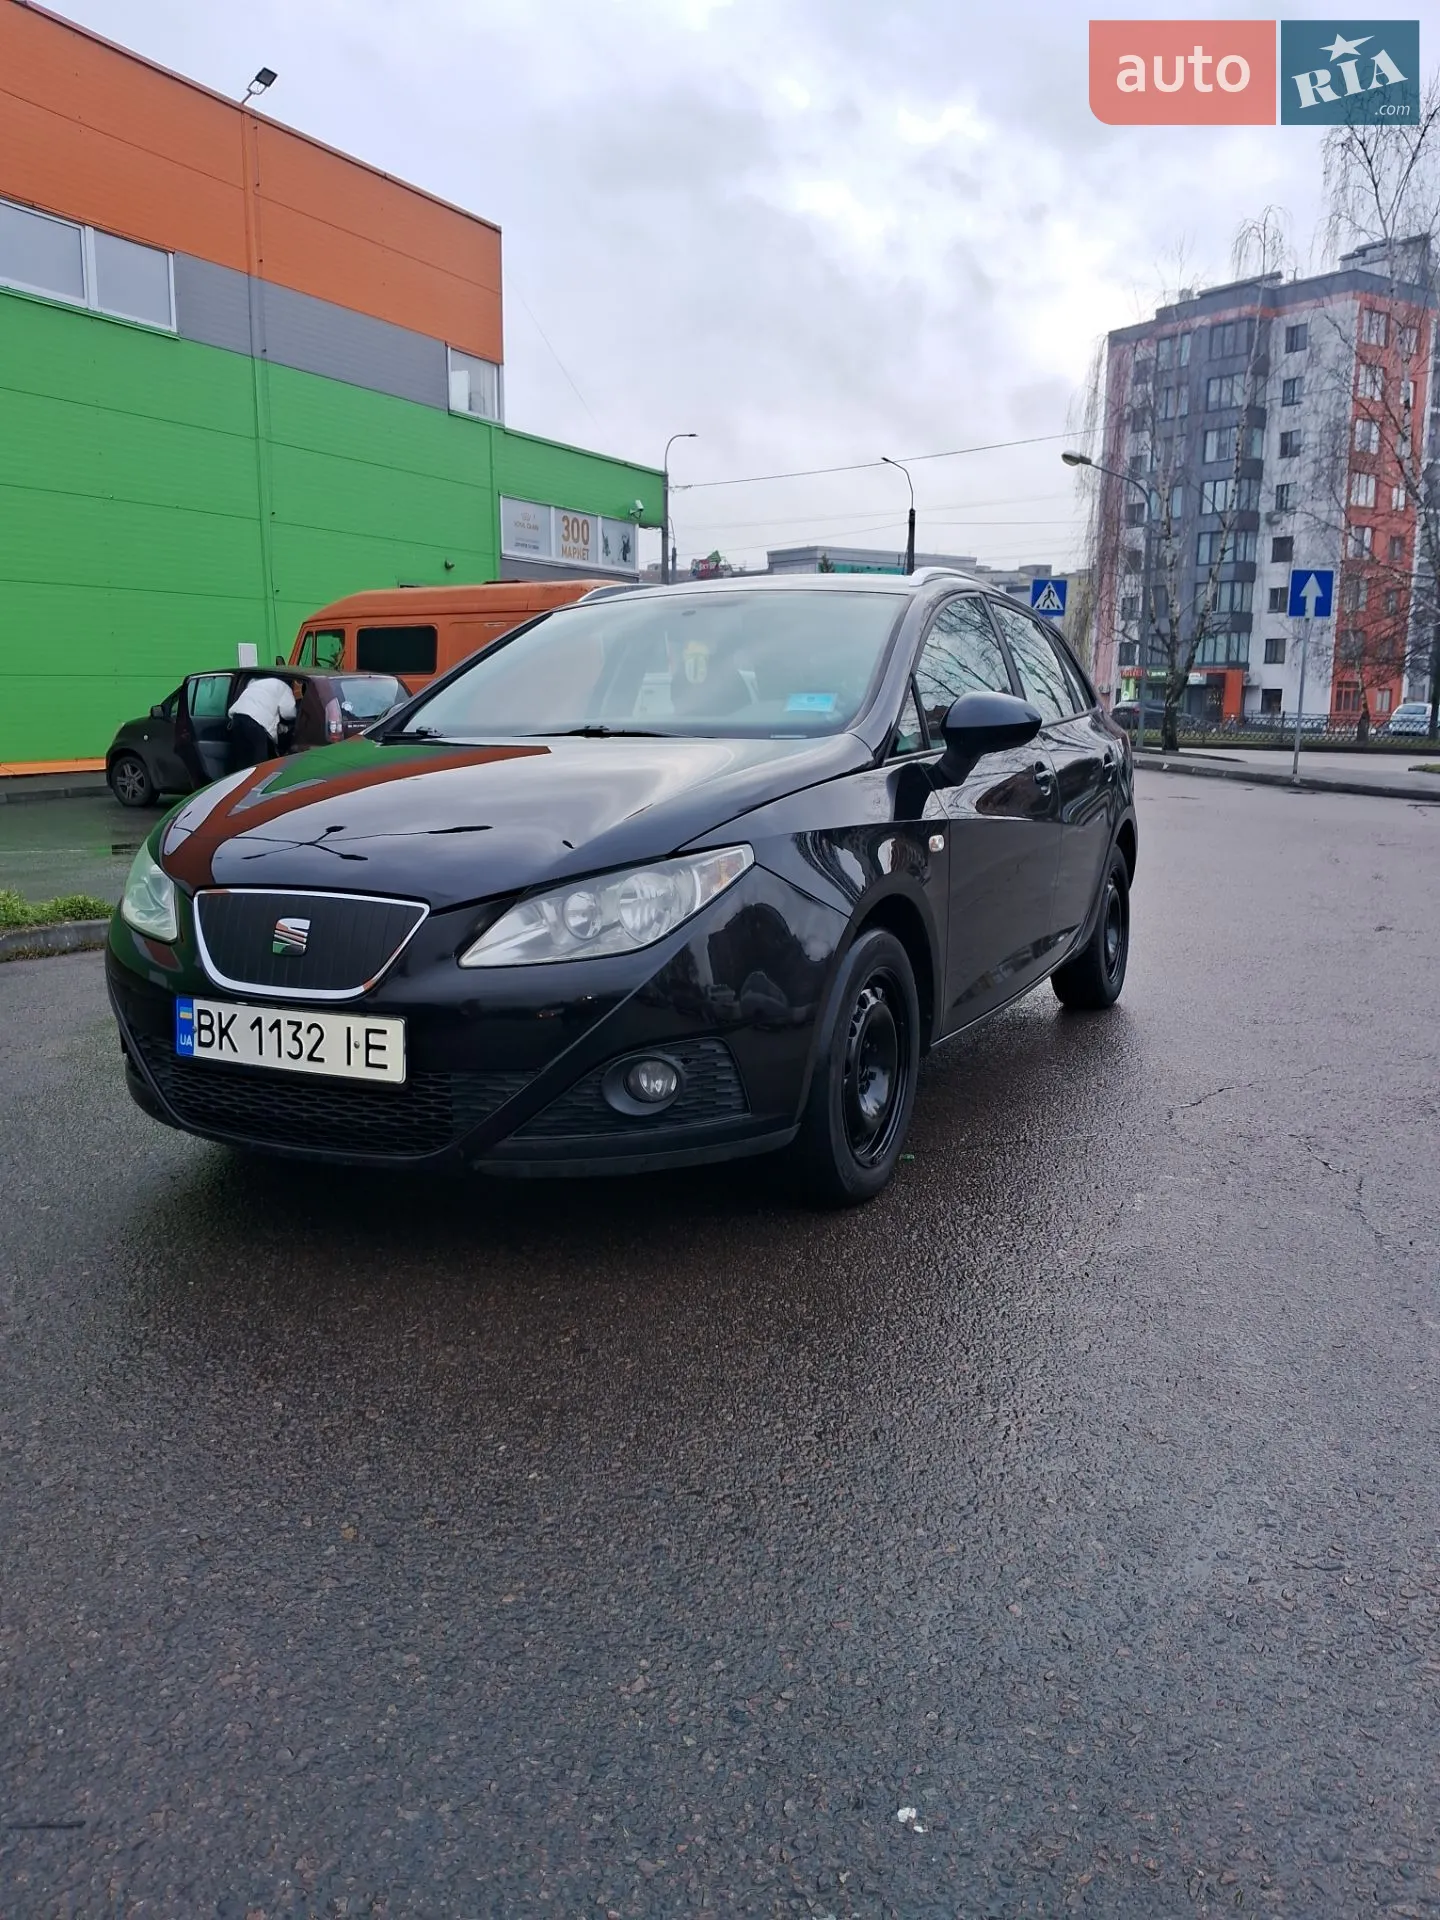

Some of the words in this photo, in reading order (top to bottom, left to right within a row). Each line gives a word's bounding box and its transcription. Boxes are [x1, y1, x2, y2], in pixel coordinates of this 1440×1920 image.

[561, 515, 590, 546] 300
[561, 543, 589, 561] МАРКЕТ
[180, 1033, 193, 1047] UA
[197, 1008, 239, 1053] BK
[250, 1016, 325, 1063] 1132
[346, 1026, 388, 1070] IE
